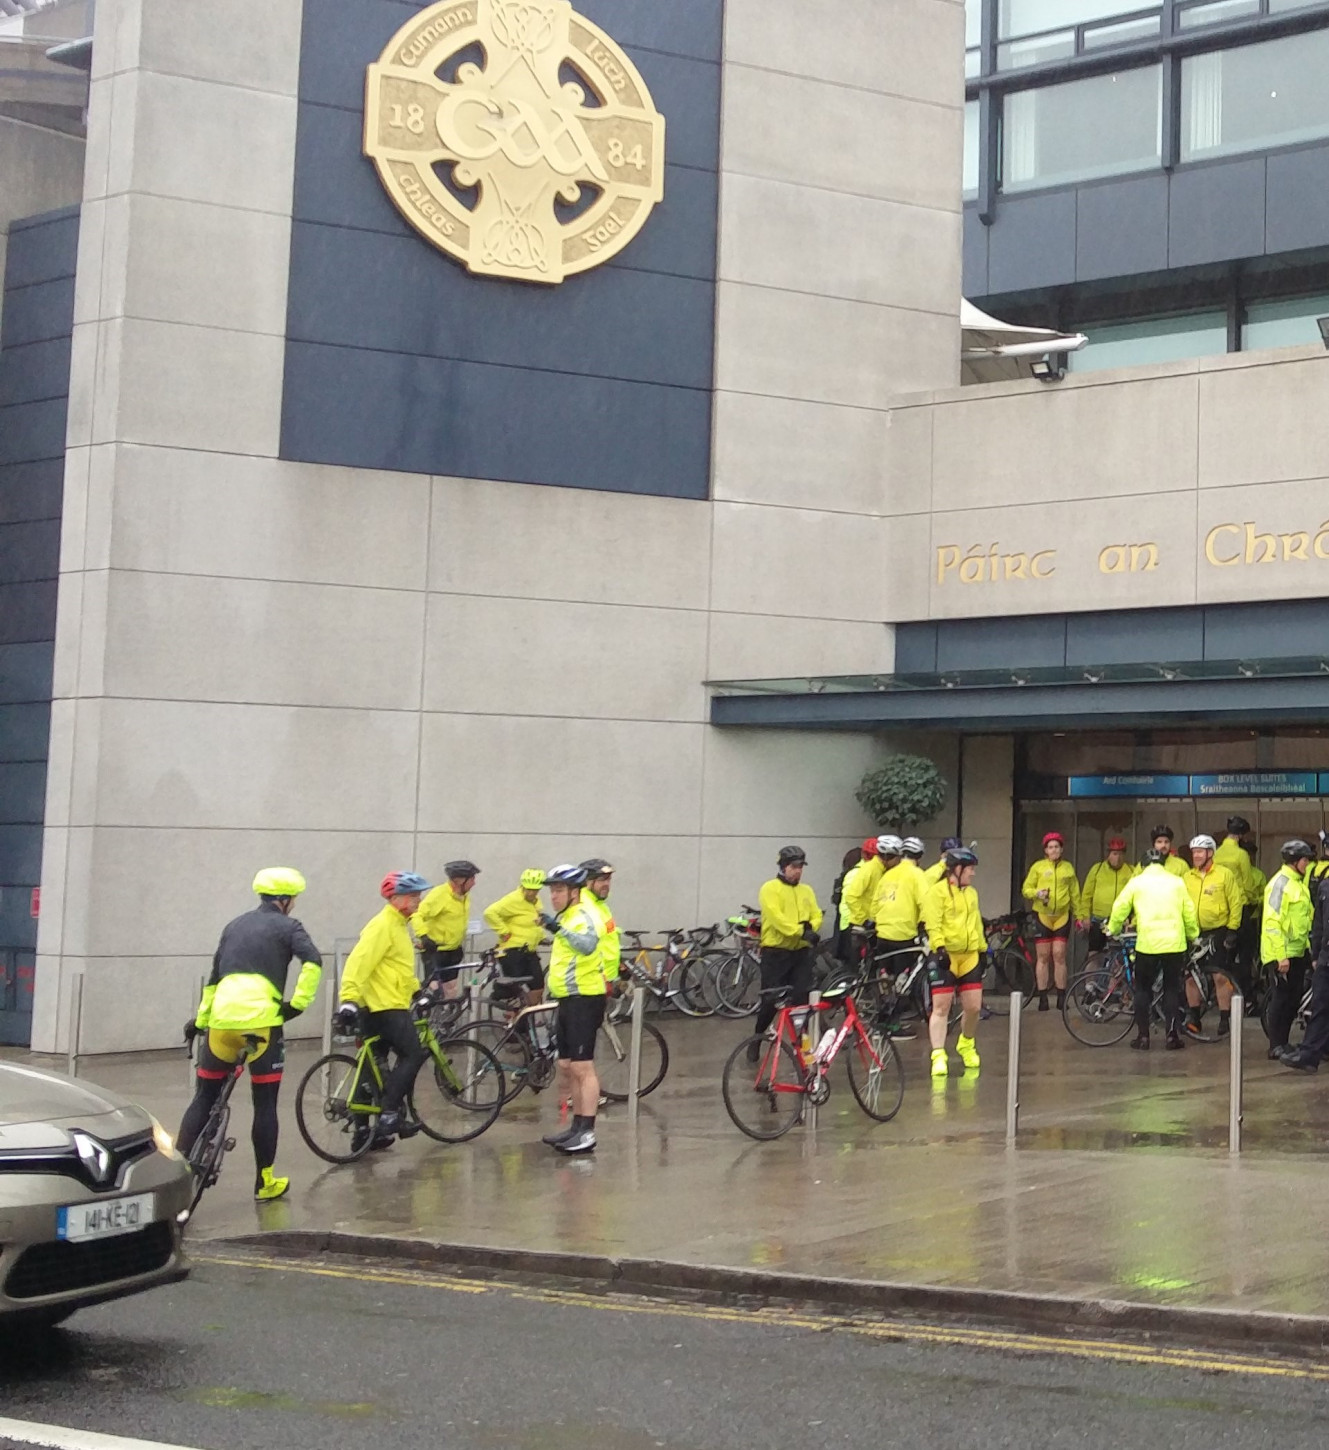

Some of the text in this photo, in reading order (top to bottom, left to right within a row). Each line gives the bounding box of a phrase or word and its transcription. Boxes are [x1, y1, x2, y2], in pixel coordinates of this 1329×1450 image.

[400, 7, 473, 67] Cumann
[389, 103, 425, 135] 18
[607, 137, 647, 171] 84
[1099, 541, 1160, 574] an
